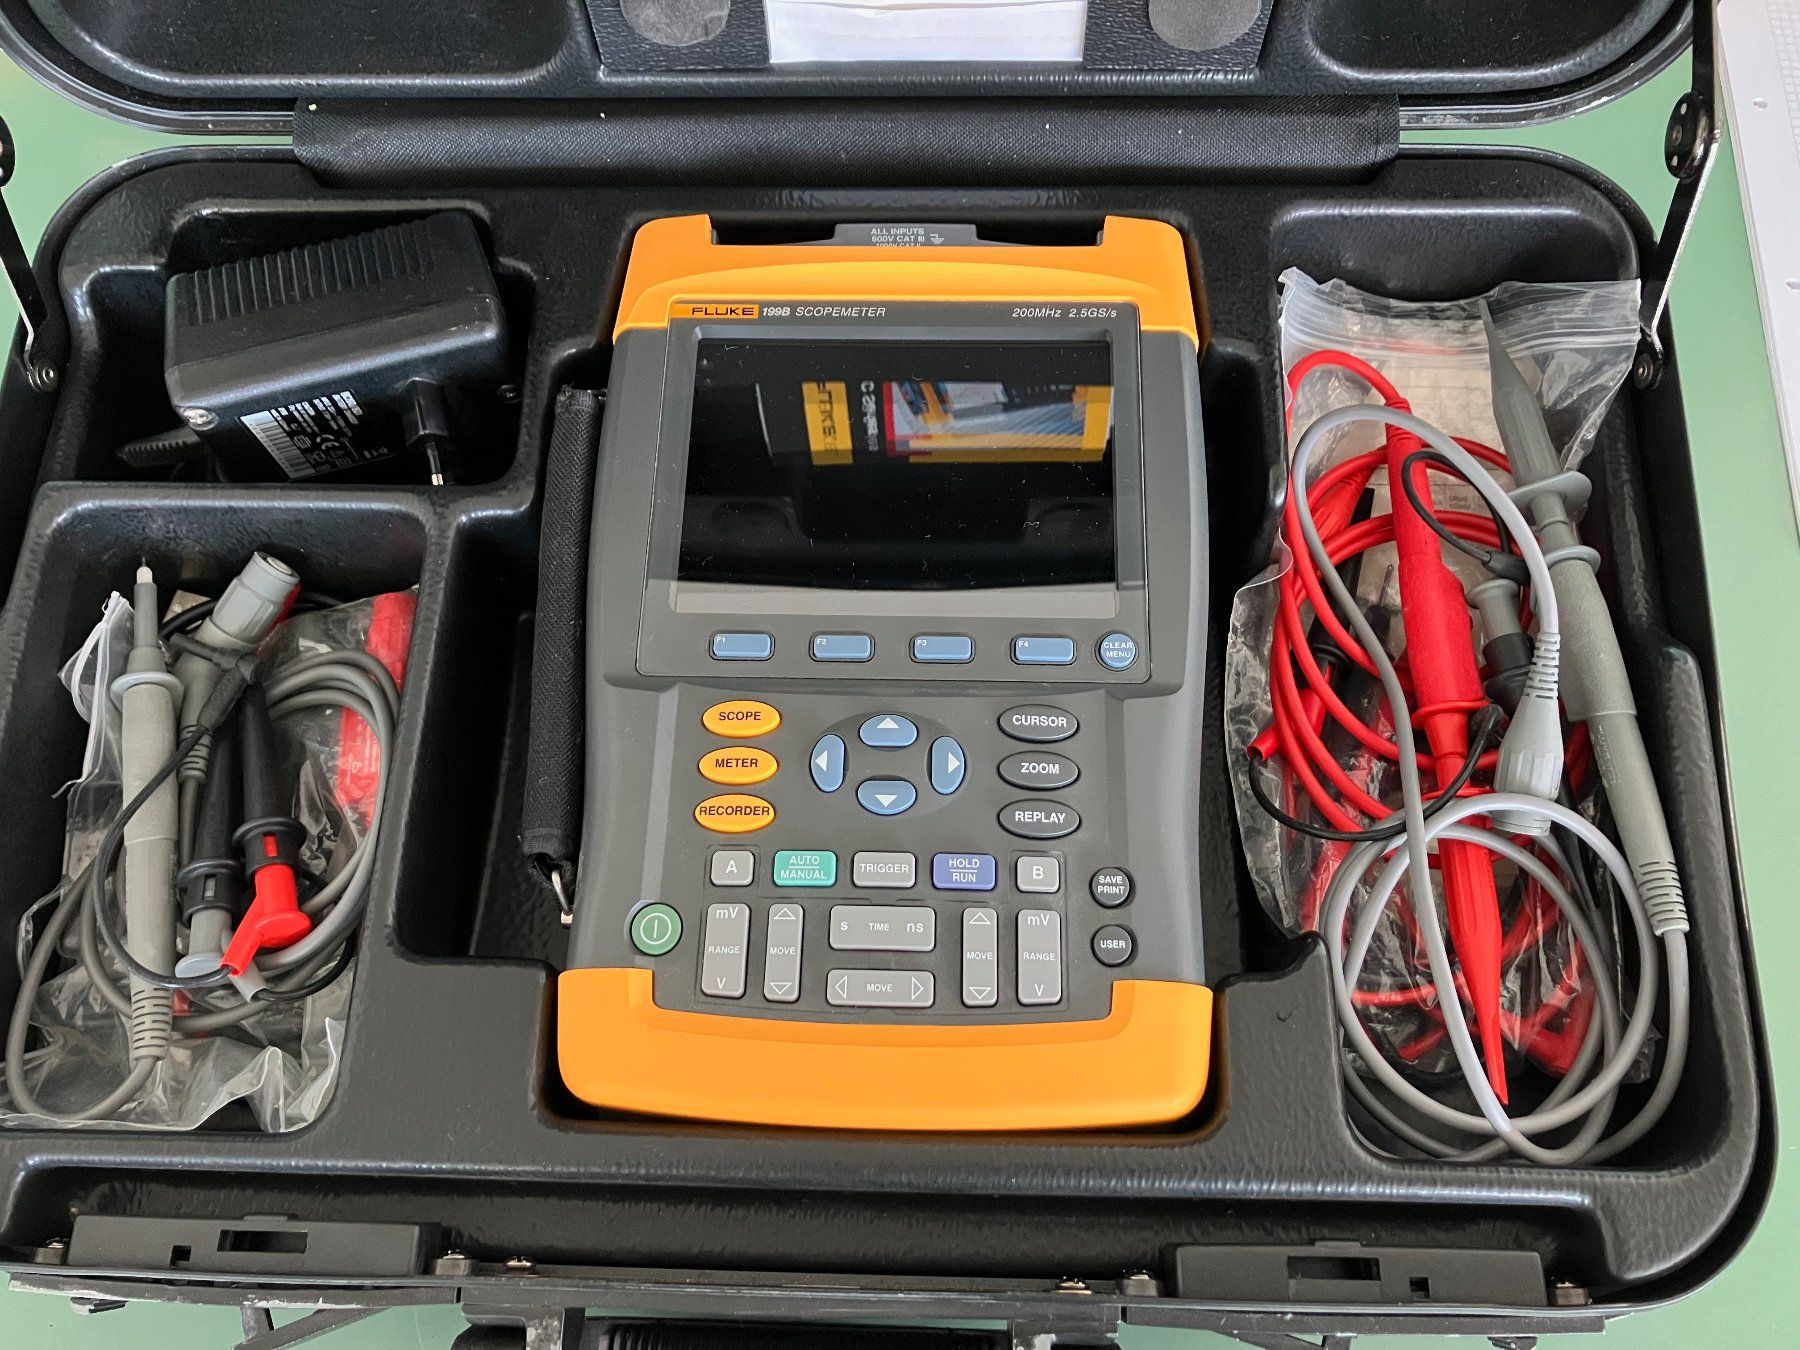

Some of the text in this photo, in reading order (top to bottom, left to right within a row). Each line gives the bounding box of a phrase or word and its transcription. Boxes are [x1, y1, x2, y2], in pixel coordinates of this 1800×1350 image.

[692, 306, 886, 316] FLUKE 199B SCOPEMETER
[1012, 307, 1117, 318] 200MHz 2.5GS/s
[718, 711, 762, 721] SCOPE
[1012, 714, 1067, 728] CURSOR
[715, 758, 758, 768] METER
[1020, 763, 1060, 774] ZOOM
[700, 806, 770, 816] RECORDER
[1015, 811, 1066, 824] REPLAY
[790, 856, 820, 865] AUTO
[949, 858, 980, 868] HOLD
[725, 860, 738, 874] A
[860, 864, 909, 874] TRIGGER
[780, 870, 827, 880] MANUAL
[952, 872, 976, 882] RUN
[1032, 866, 1044, 880] B
[1098, 876, 1123, 884] SAVE
[1098, 886, 1125, 894] PRINT
[716, 907, 738, 919] mV
[1028, 914, 1050, 926] mV
[868, 923, 890, 931] TIME
[906, 922, 924, 932] ns
[1100, 940, 1126, 948] USER
[708, 946, 740, 954] RANGE
[770, 946, 796, 955] MOVE
[966, 952, 993, 960] MOVE
[1023, 952, 1056, 961] RANGE
[716, 977, 726, 990] V
[866, 984, 893, 992] MOVE
[1034, 984, 1044, 997] V
